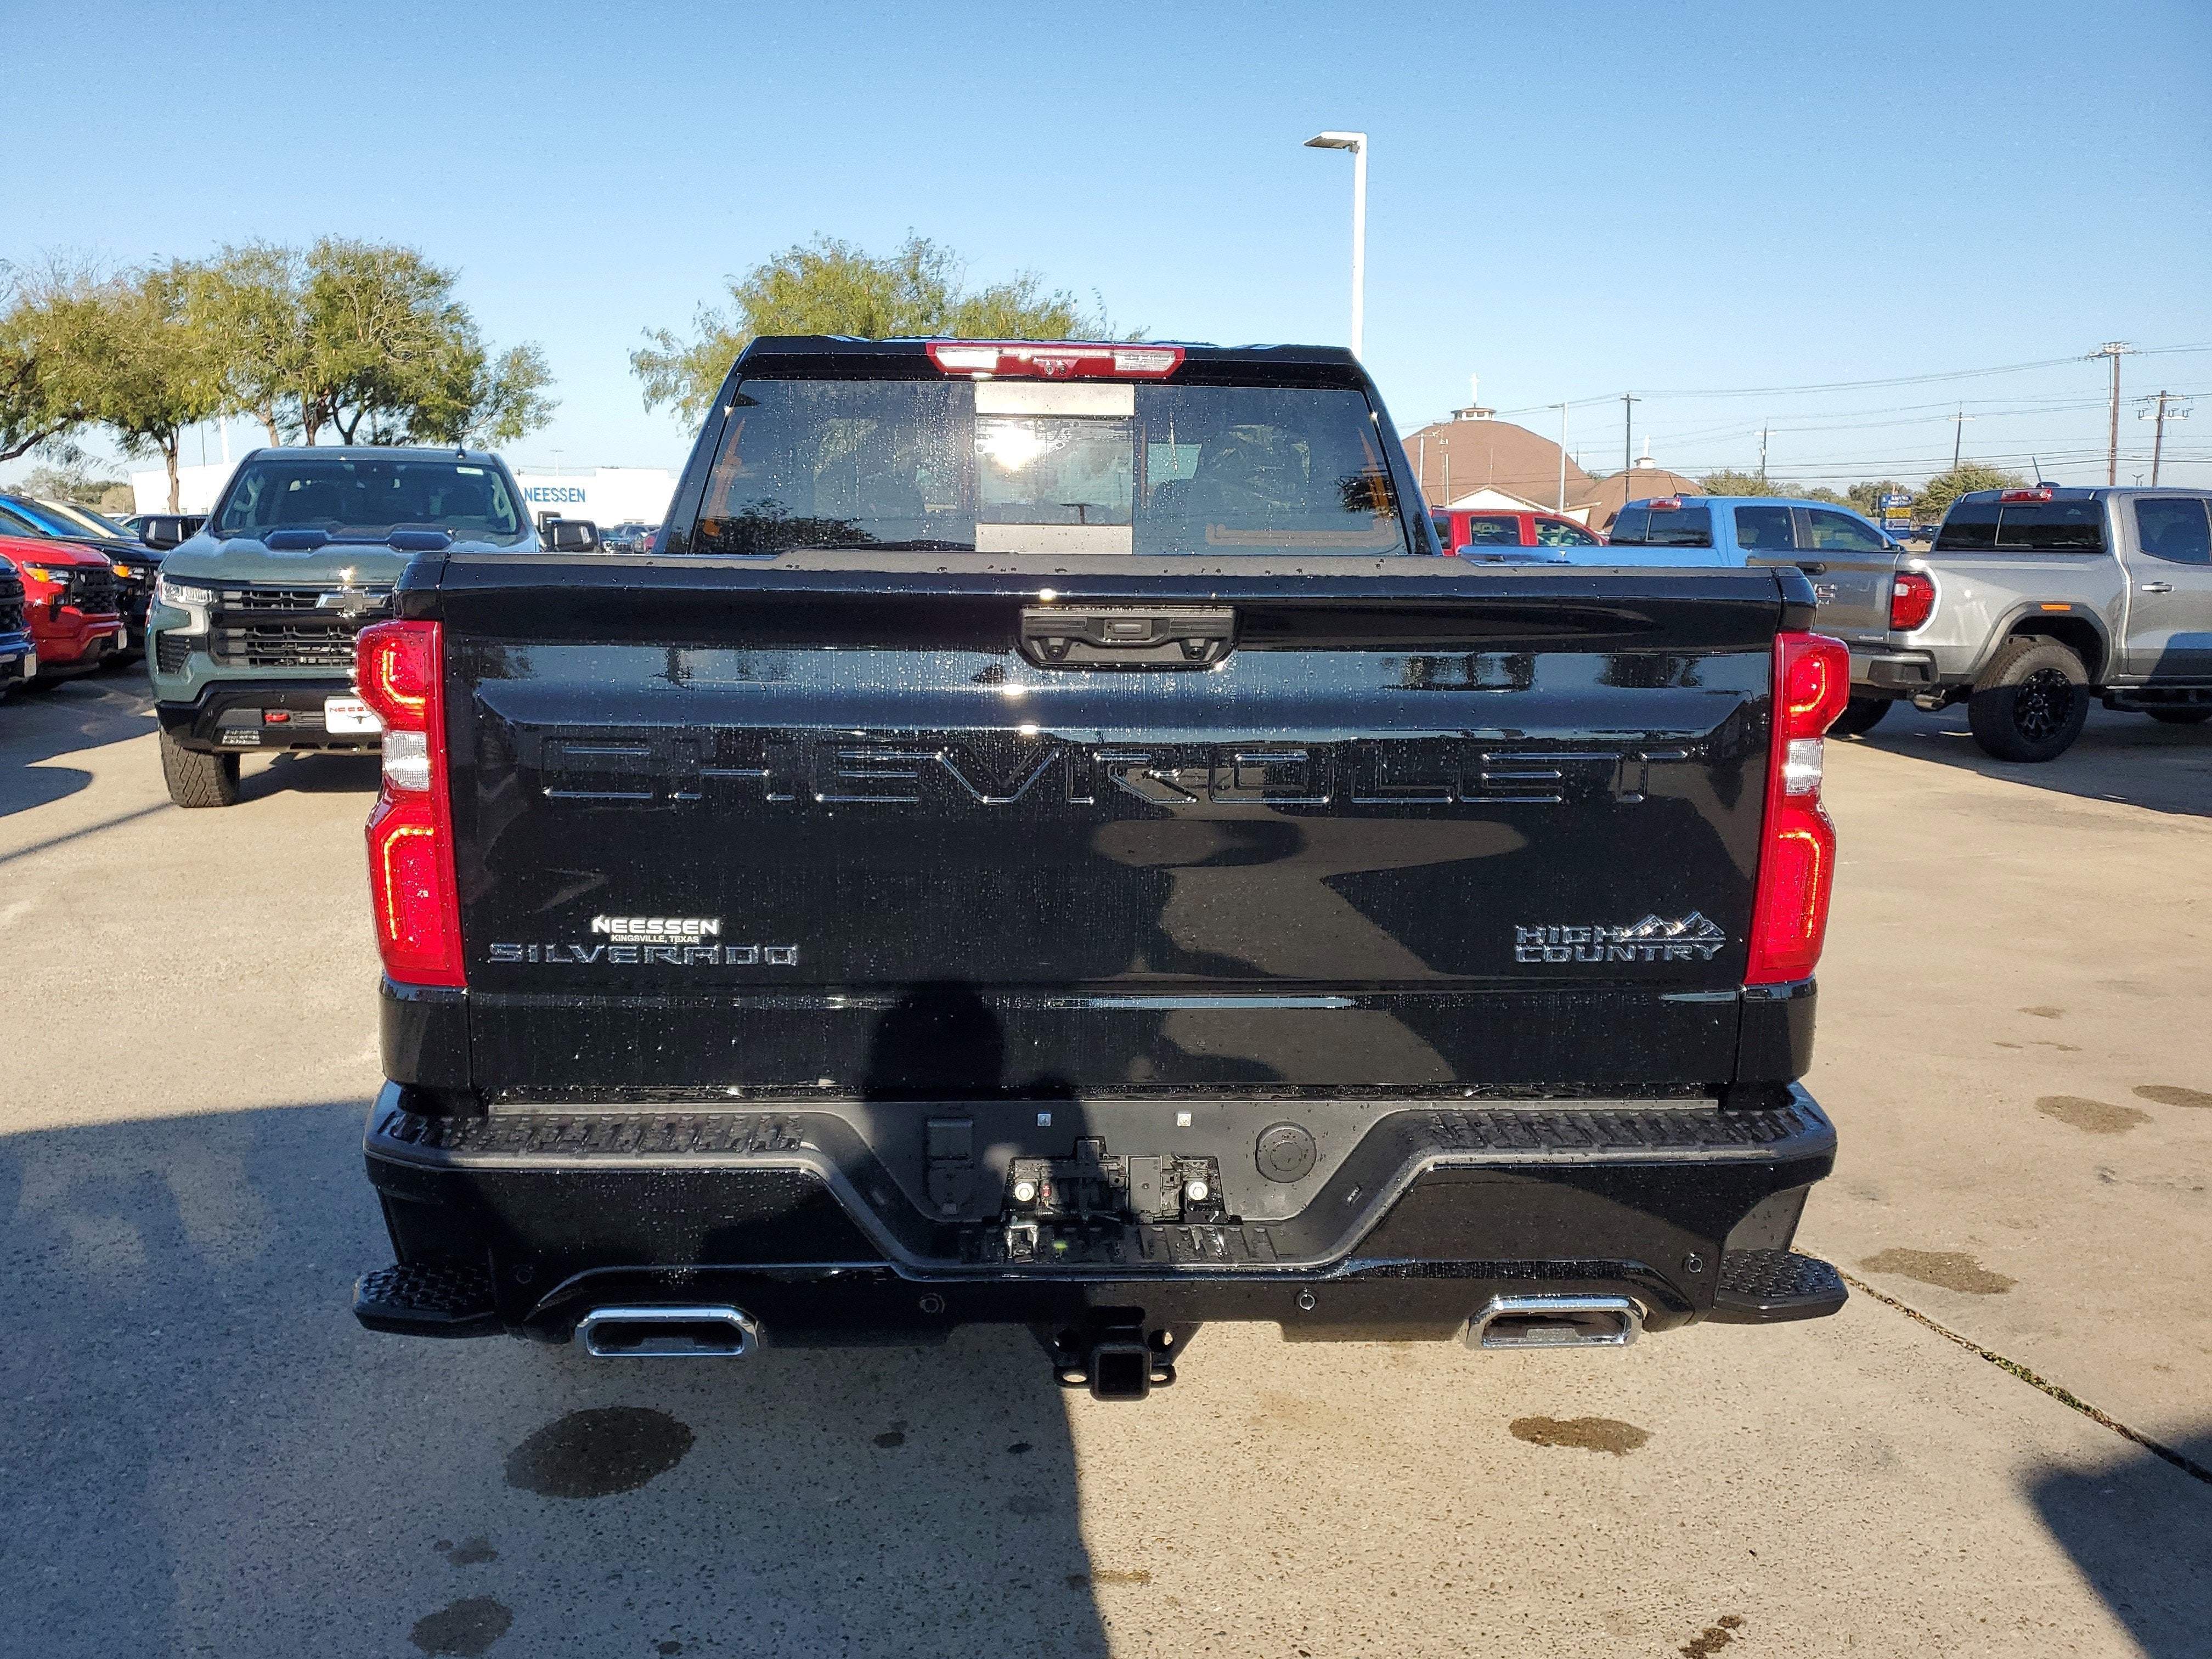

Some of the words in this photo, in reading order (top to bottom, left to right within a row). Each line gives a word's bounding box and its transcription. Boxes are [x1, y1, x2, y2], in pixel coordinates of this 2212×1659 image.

[524, 487, 585, 503] NEESSEN
[541, 736, 1687, 803] CHEVROLET
[592, 917, 718, 935] NEESSEN
[1516, 925, 1624, 943] HIGH
[611, 934, 667, 943] KINGSVILLE,
[489, 942, 798, 966] SILVERADO
[1516, 944, 1724, 963] COUNTRY
